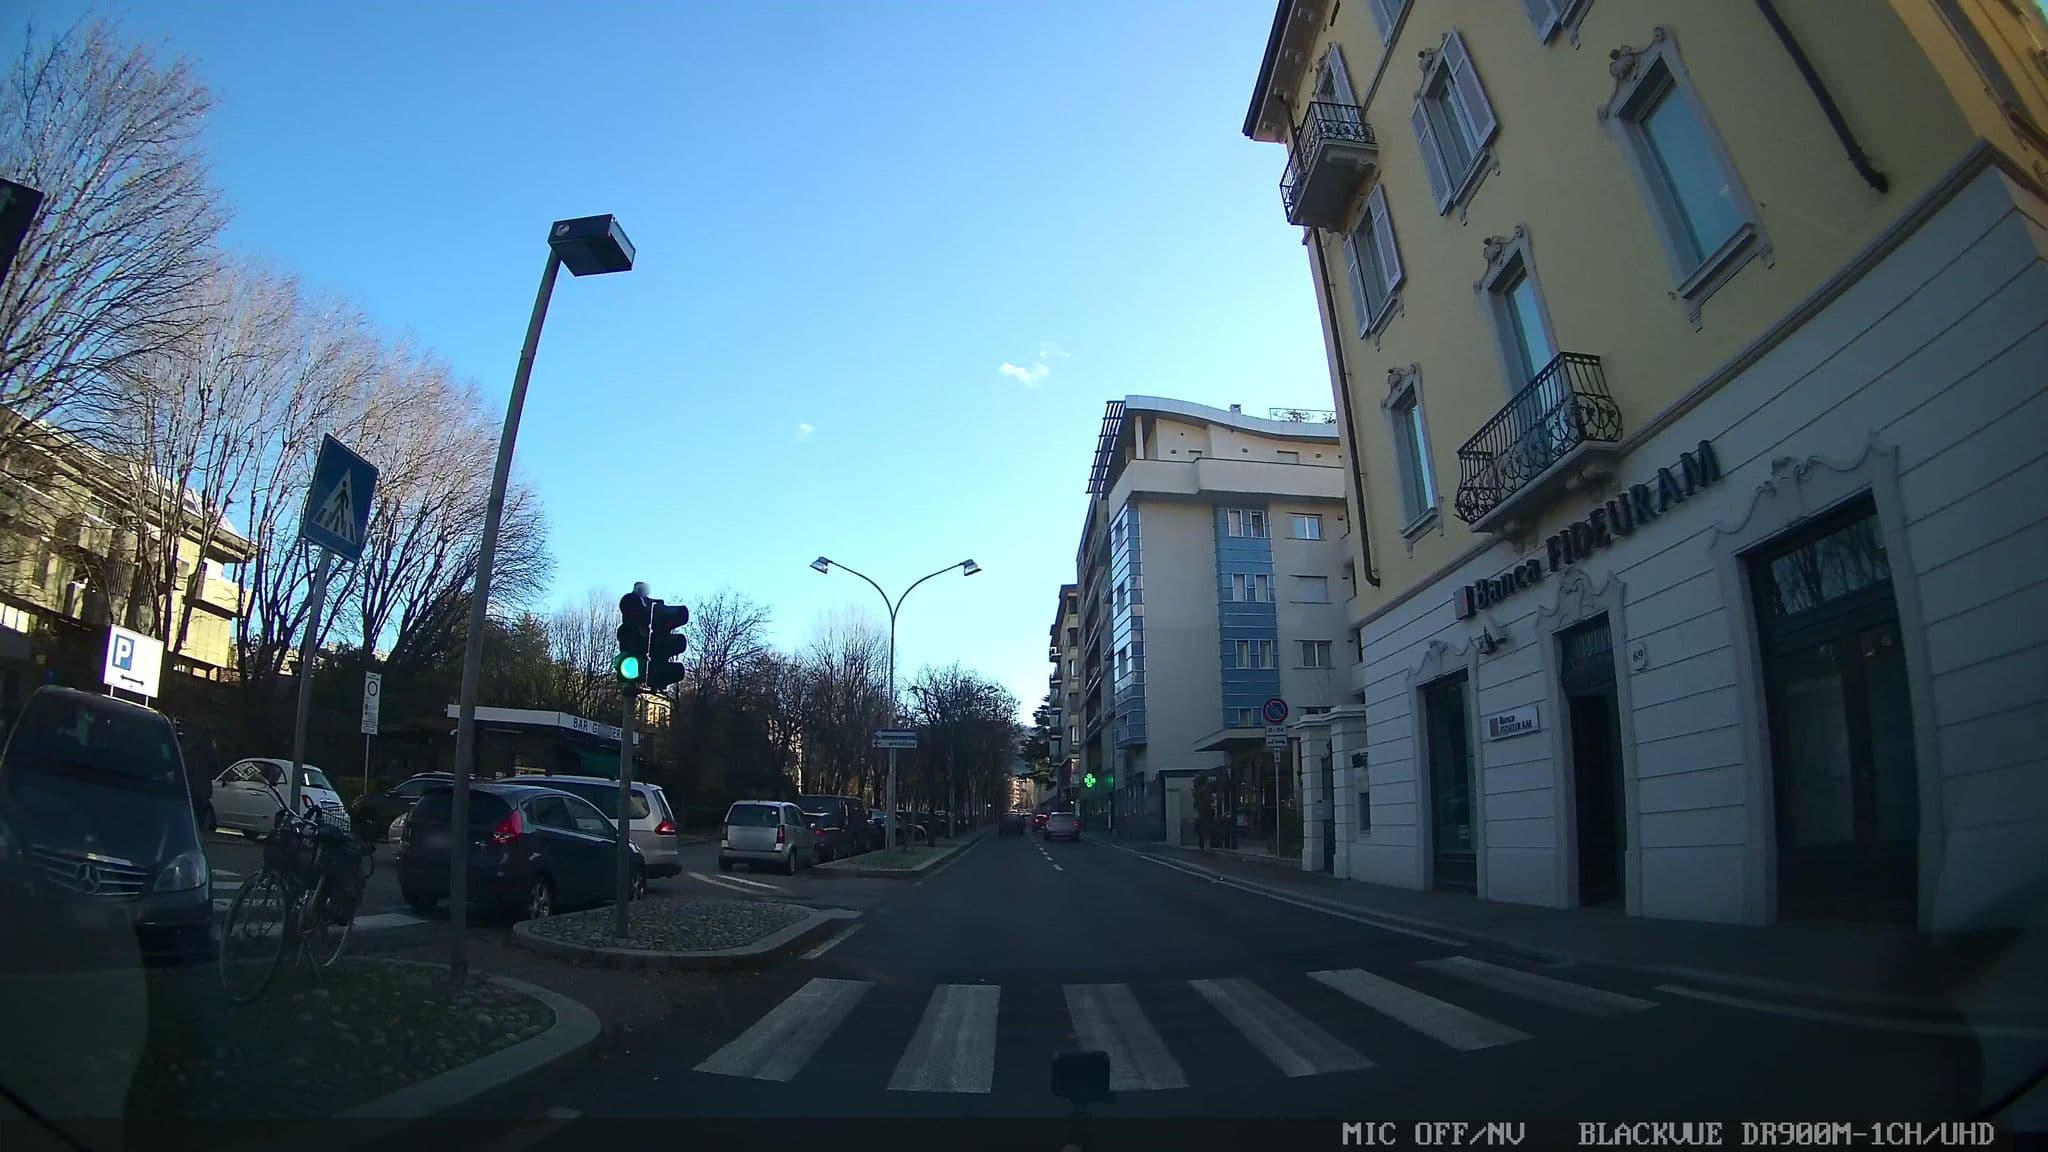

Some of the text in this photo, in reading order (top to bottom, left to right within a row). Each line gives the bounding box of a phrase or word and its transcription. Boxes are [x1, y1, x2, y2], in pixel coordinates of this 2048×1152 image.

[1475, 440, 1721, 610] Banca FIDEURAM
[573, 717, 588, 732] BAR
